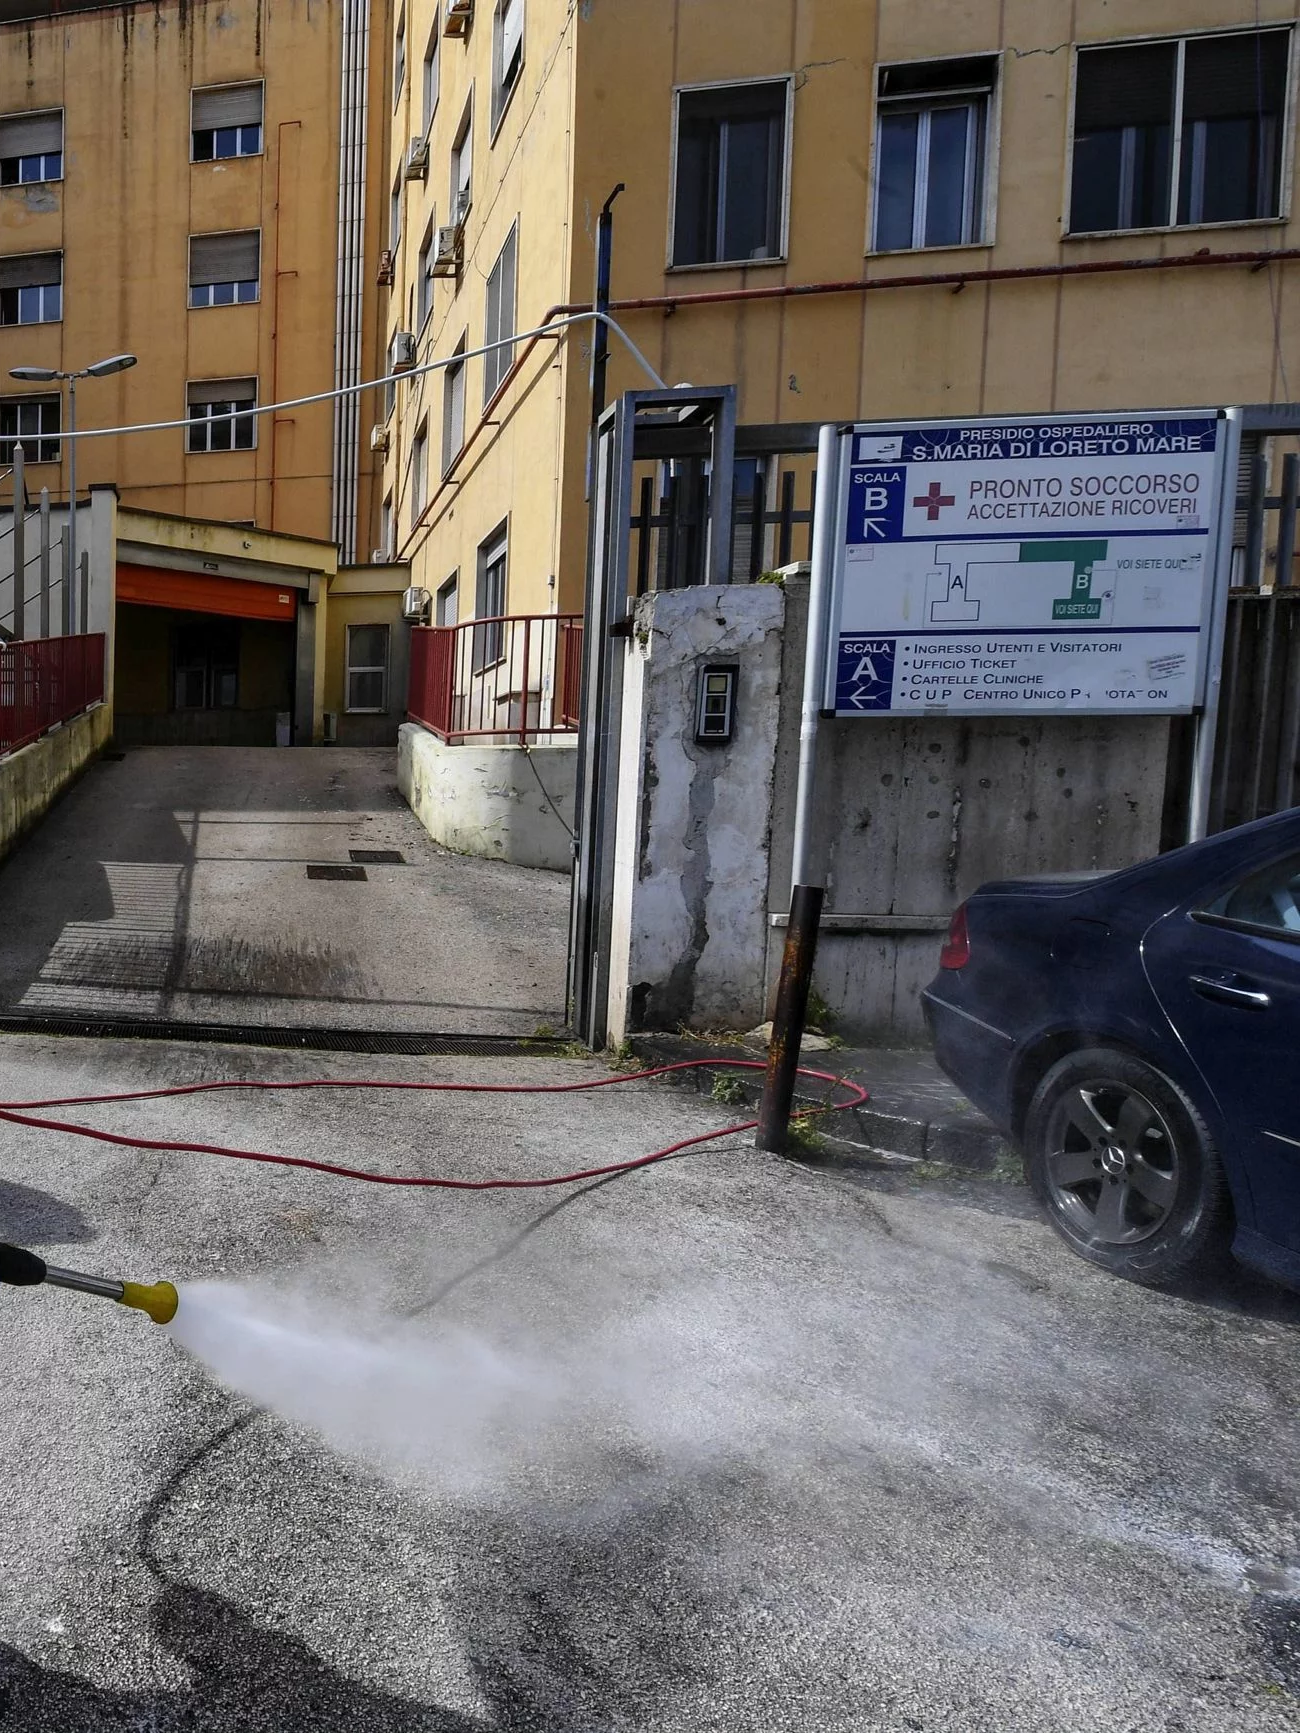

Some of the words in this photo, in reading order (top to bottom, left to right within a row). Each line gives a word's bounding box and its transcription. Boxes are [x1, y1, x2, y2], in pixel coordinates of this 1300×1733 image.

[960, 428, 1035, 441] PRESIDIO
[1039, 423, 1153, 438] OSPEDALIERO
[912, 443, 1003, 460] S.MARIA
[1010, 442, 1031, 457] DI
[1039, 438, 1129, 456] LORETO
[1136, 436, 1201, 452] MARE
[854, 472, 901, 484] SCALA
[969, 477, 1062, 499] PRONTO
[1070, 473, 1200, 497] SOCCORSO
[865, 487, 888, 511] B
[967, 500, 1105, 520] ACCETTAZIONE
[1111, 498, 1197, 515] RICOVERI
[1117, 559, 1133, 569] VOI
[1134, 559, 1161, 569] SIETE
[951, 575, 964, 589] A
[1075, 574, 1089, 589] B
[1055, 604, 1065, 615] VOI
[1066, 604, 1085, 615] SIETE
[1086, 603, 1099, 614] QUI
[843, 643, 891, 654] SCALA
[851, 657, 878, 681] A
